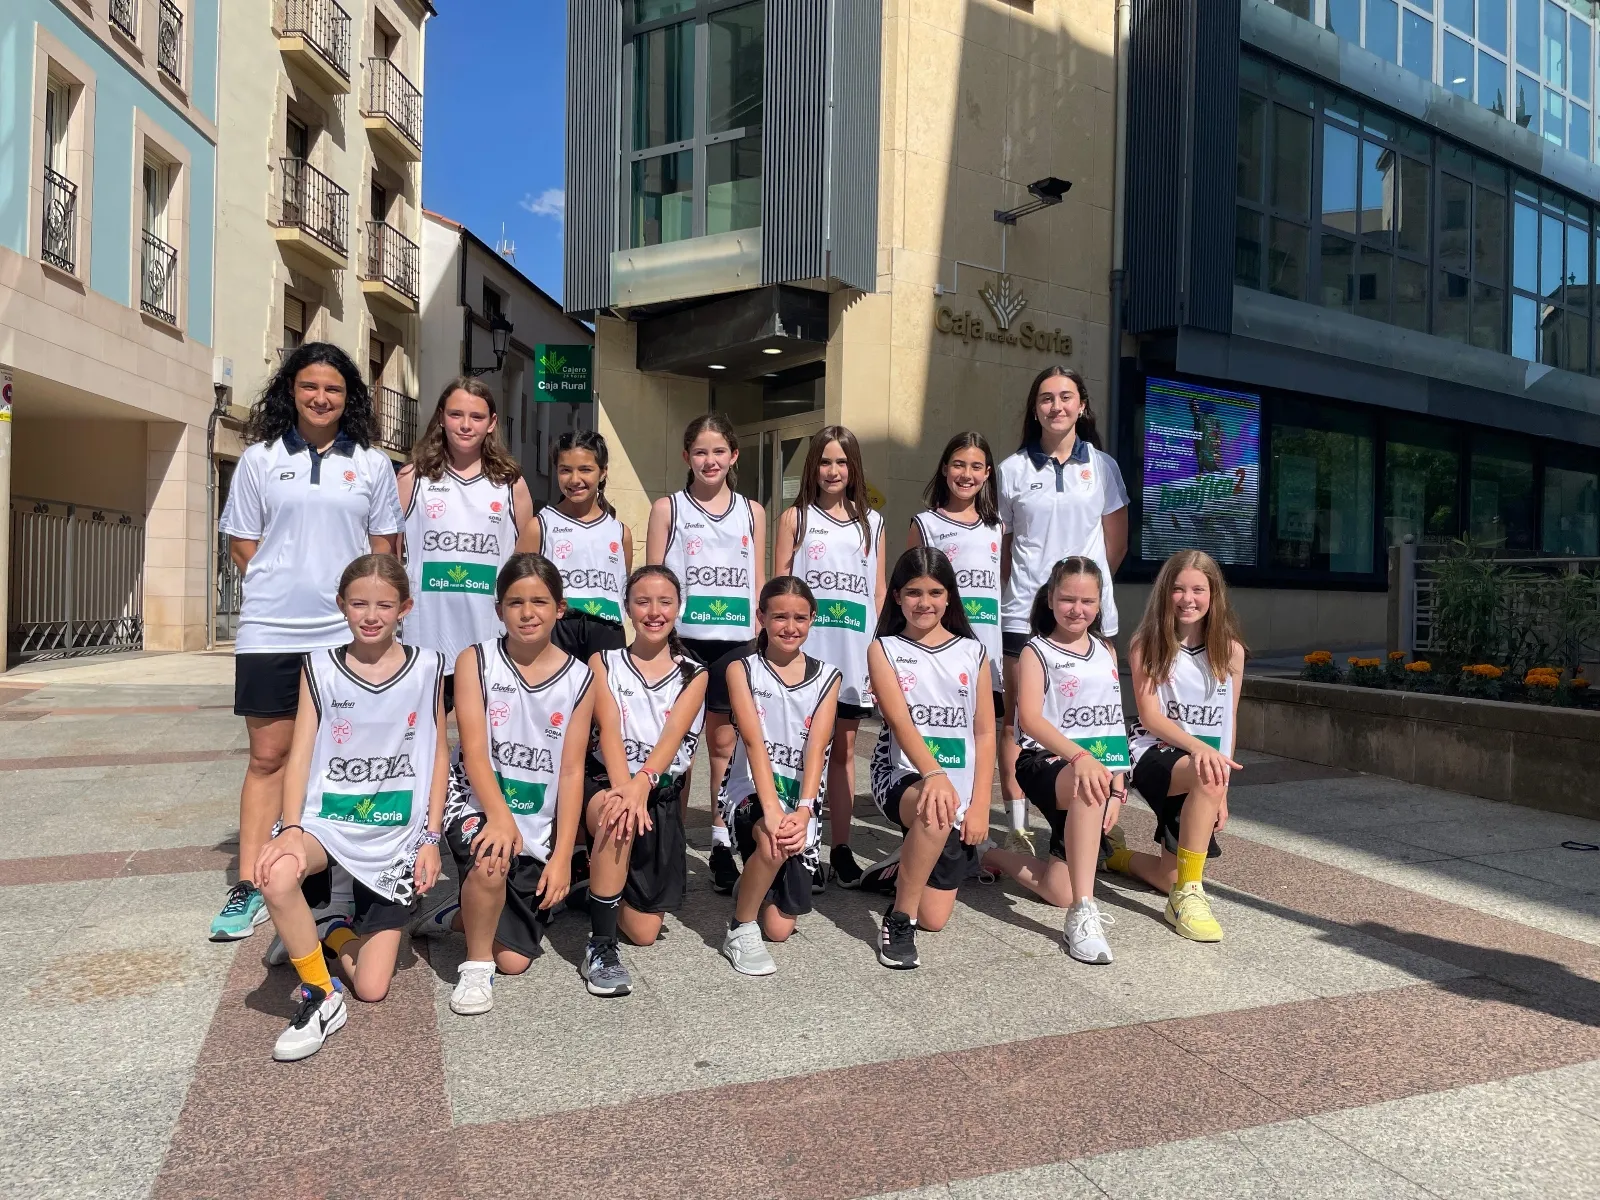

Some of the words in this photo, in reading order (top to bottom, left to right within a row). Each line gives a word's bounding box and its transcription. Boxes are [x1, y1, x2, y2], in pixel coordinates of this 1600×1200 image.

[934, 306, 984, 343] Caja
[1020, 322, 1073, 355] Soria
[562, 366, 587, 374] Cajero
[538, 381, 558, 391] Caja
[562, 382, 586, 390] Rural
[423, 530, 501, 556] SORIA
[558, 569, 619, 592] SORIA
[686, 566, 750, 588] SORIA
[429, 578, 449, 589] Caja
[465, 580, 490, 590] Soria
[805, 570, 869, 597] SORIA
[690, 611, 711, 622] Caja
[725, 612, 746, 622] Soria
[844, 615, 861, 627] Soria
[980, 612, 997, 621] Soria
[907, 703, 968, 728] ORIA
[1061, 704, 1125, 729] SORIA
[938, 754, 961, 764] Soria
[1106, 753, 1124, 762] Soria
[326, 754, 417, 784] SORIA
[511, 799, 535, 810] Soria
[373, 811, 402, 823] Soria
